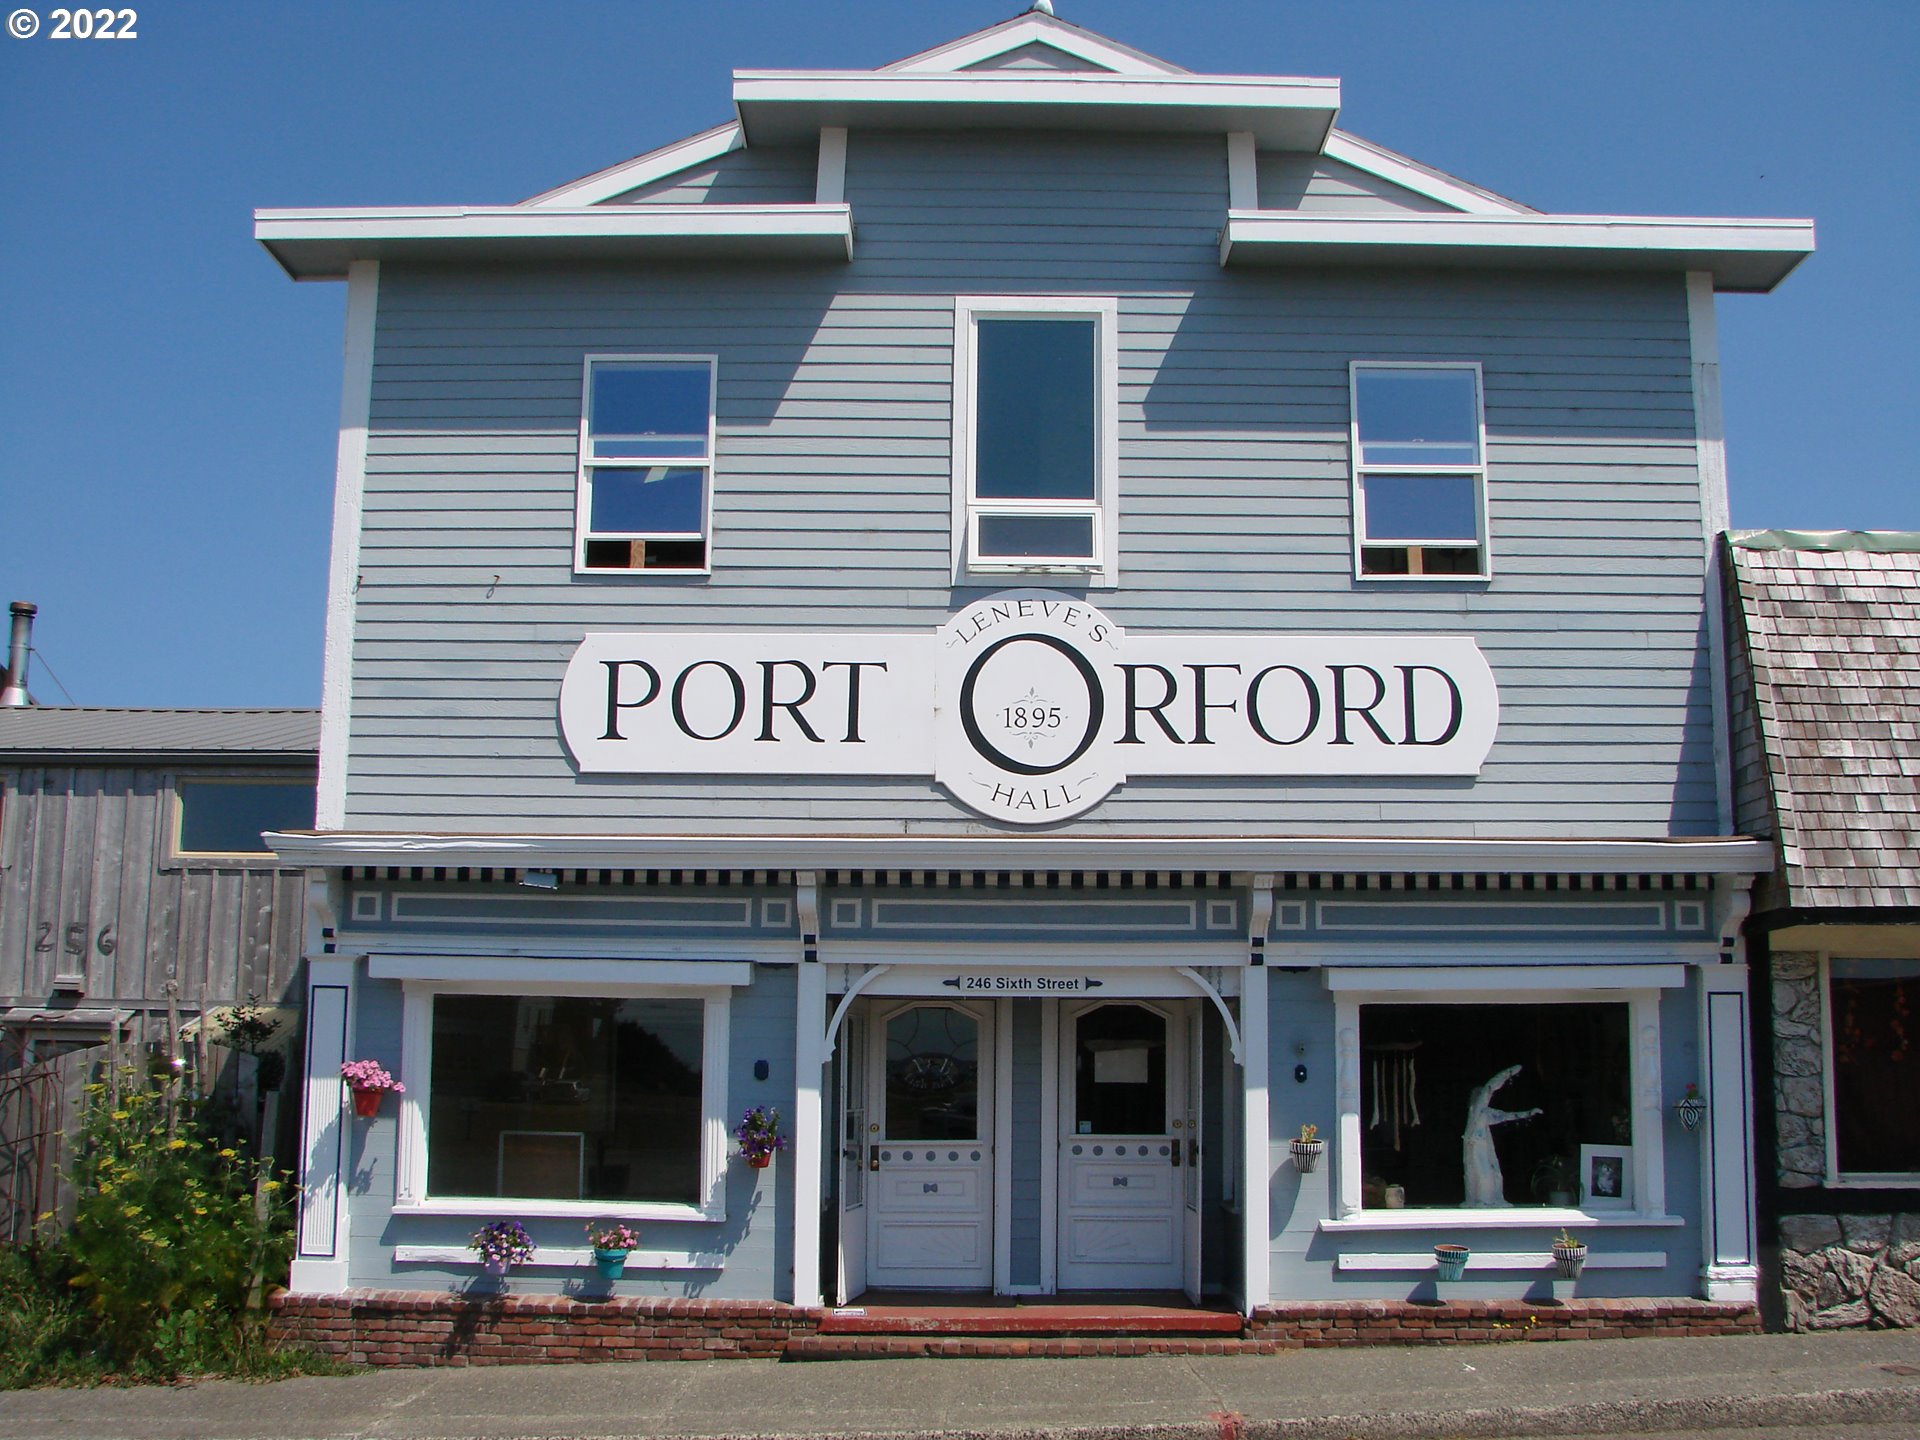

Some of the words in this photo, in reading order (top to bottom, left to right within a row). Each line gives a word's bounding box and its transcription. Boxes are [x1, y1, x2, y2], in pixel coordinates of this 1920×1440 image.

[956, 599, 1108, 643] LENEVE'S
[596, 659, 888, 743] PORT
[959, 632, 1463, 776] ORFORD
[1003, 706, 1061, 729] 1895
[990, 783, 1081, 810] HALL
[35, 921, 117, 956] 256
[966, 977, 992, 989] 246
[996, 977, 1032, 990] Sixth
[1036, 977, 1079, 990] Street
